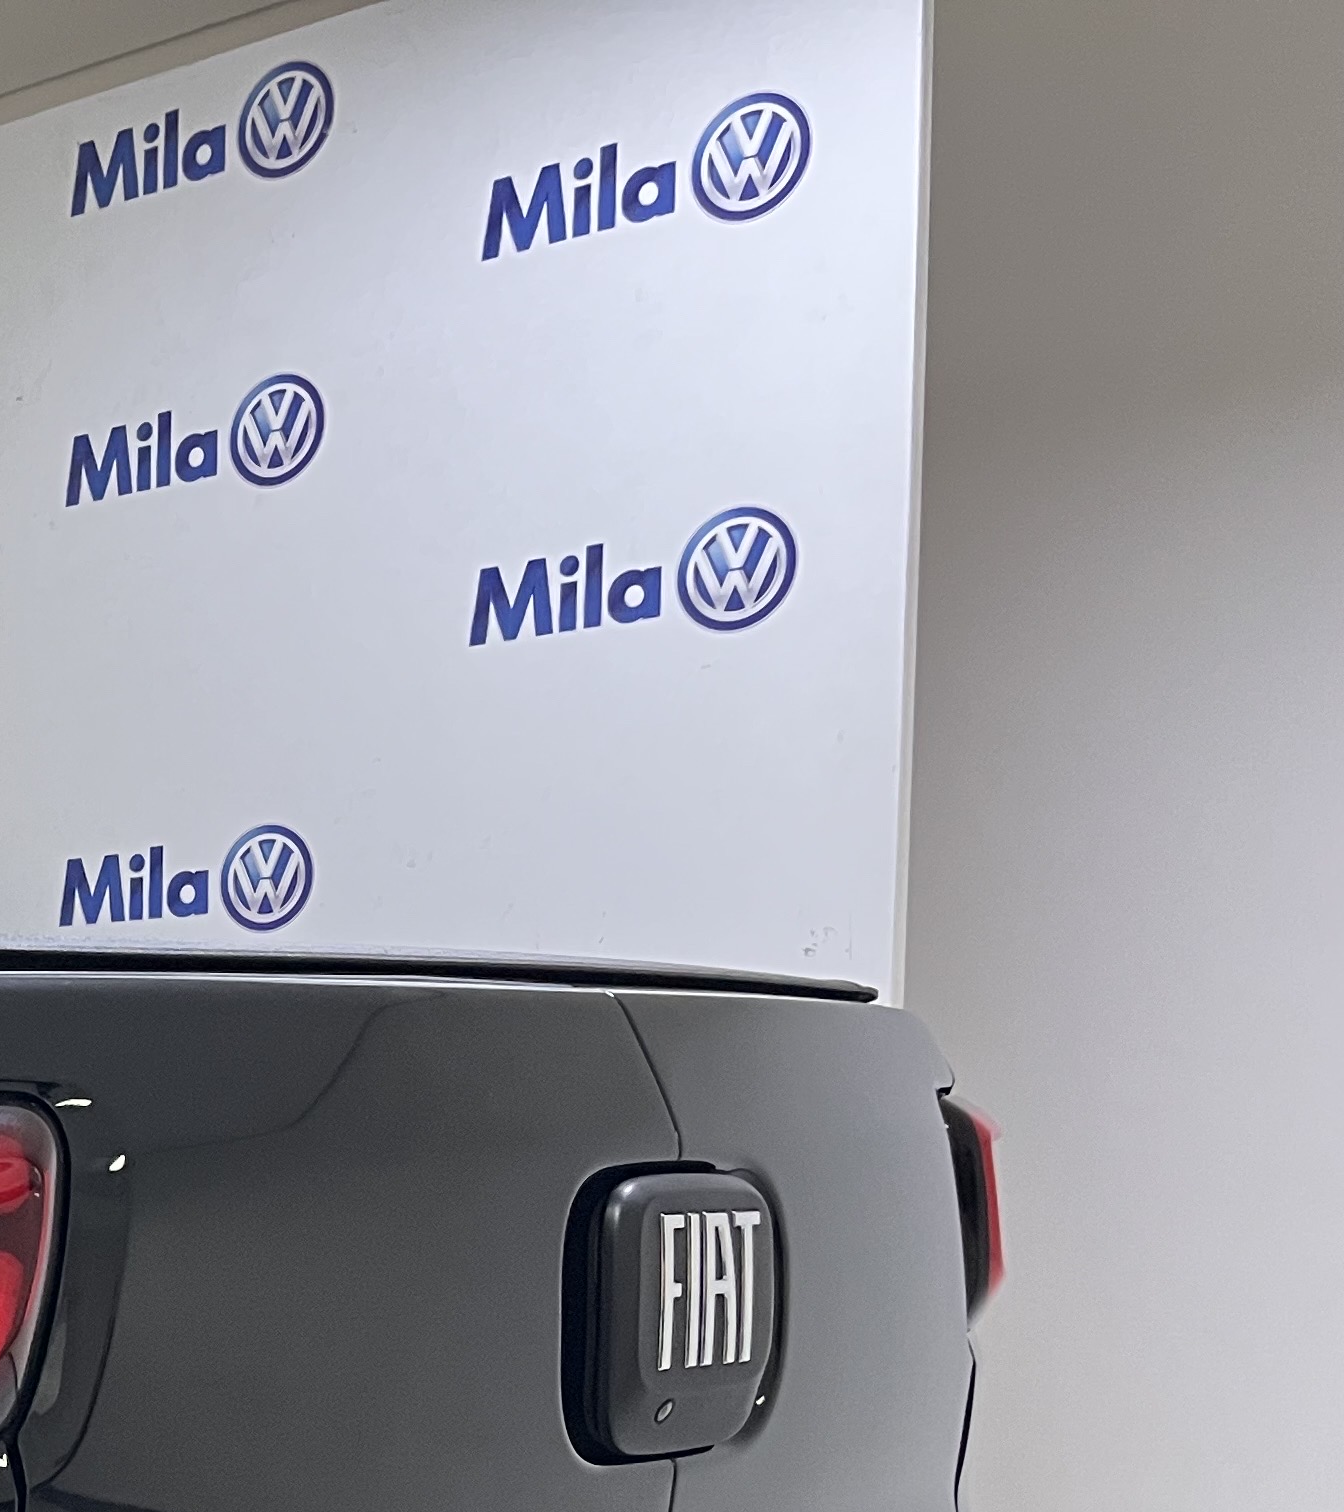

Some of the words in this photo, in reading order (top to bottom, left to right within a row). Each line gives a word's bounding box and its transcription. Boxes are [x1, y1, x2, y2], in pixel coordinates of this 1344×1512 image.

[70, 108, 227, 218] Mila
[481, 142, 677, 262] Mila
[65, 410, 218, 508] Mila
[468, 542, 663, 648] Mila
[58, 845, 210, 928] Mila
[658, 1210, 761, 1371] FIAT
